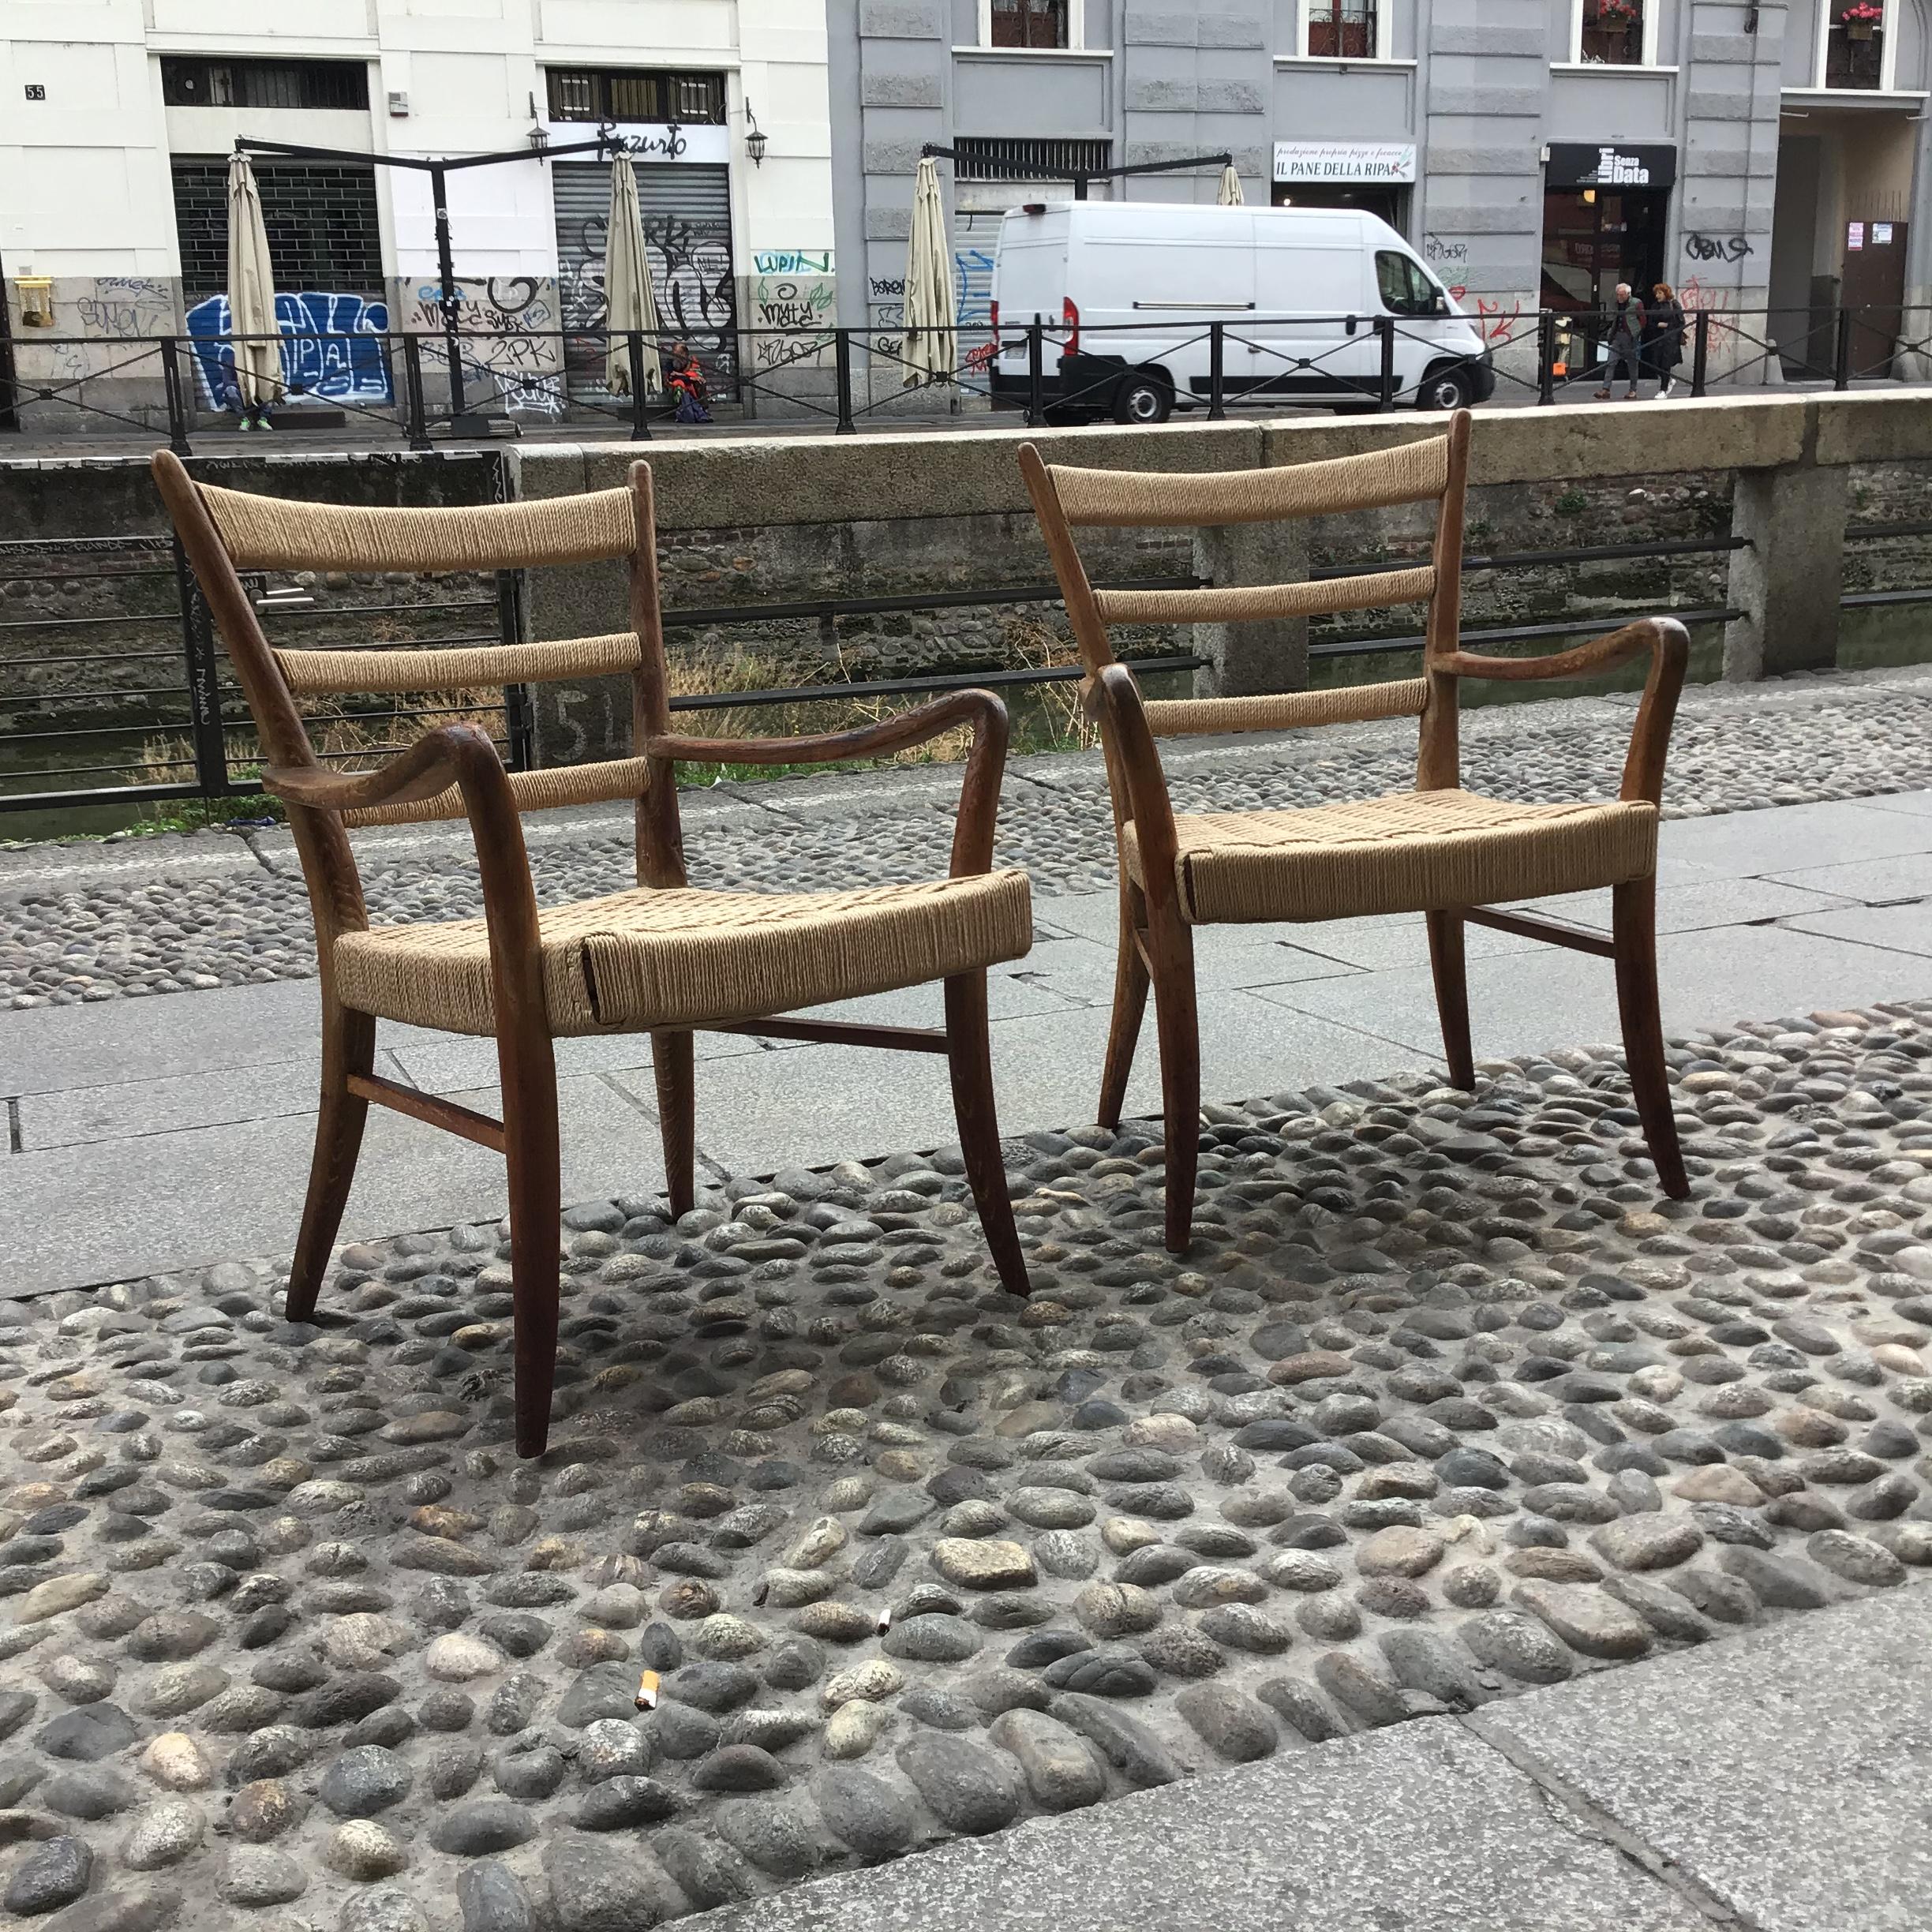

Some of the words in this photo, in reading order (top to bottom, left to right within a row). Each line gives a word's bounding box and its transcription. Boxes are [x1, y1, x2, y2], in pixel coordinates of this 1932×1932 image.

[27, 86, 43, 99] 55
[1597, 148, 1615, 183] Libri
[1614, 155, 1639, 167] Senza
[1276, 162, 1287, 175] IL
[1290, 162, 1321, 175] PANE
[1324, 163, 1361, 176] DELLA
[1365, 163, 1391, 176] RIPA
[1613, 167, 1649, 184] Data
